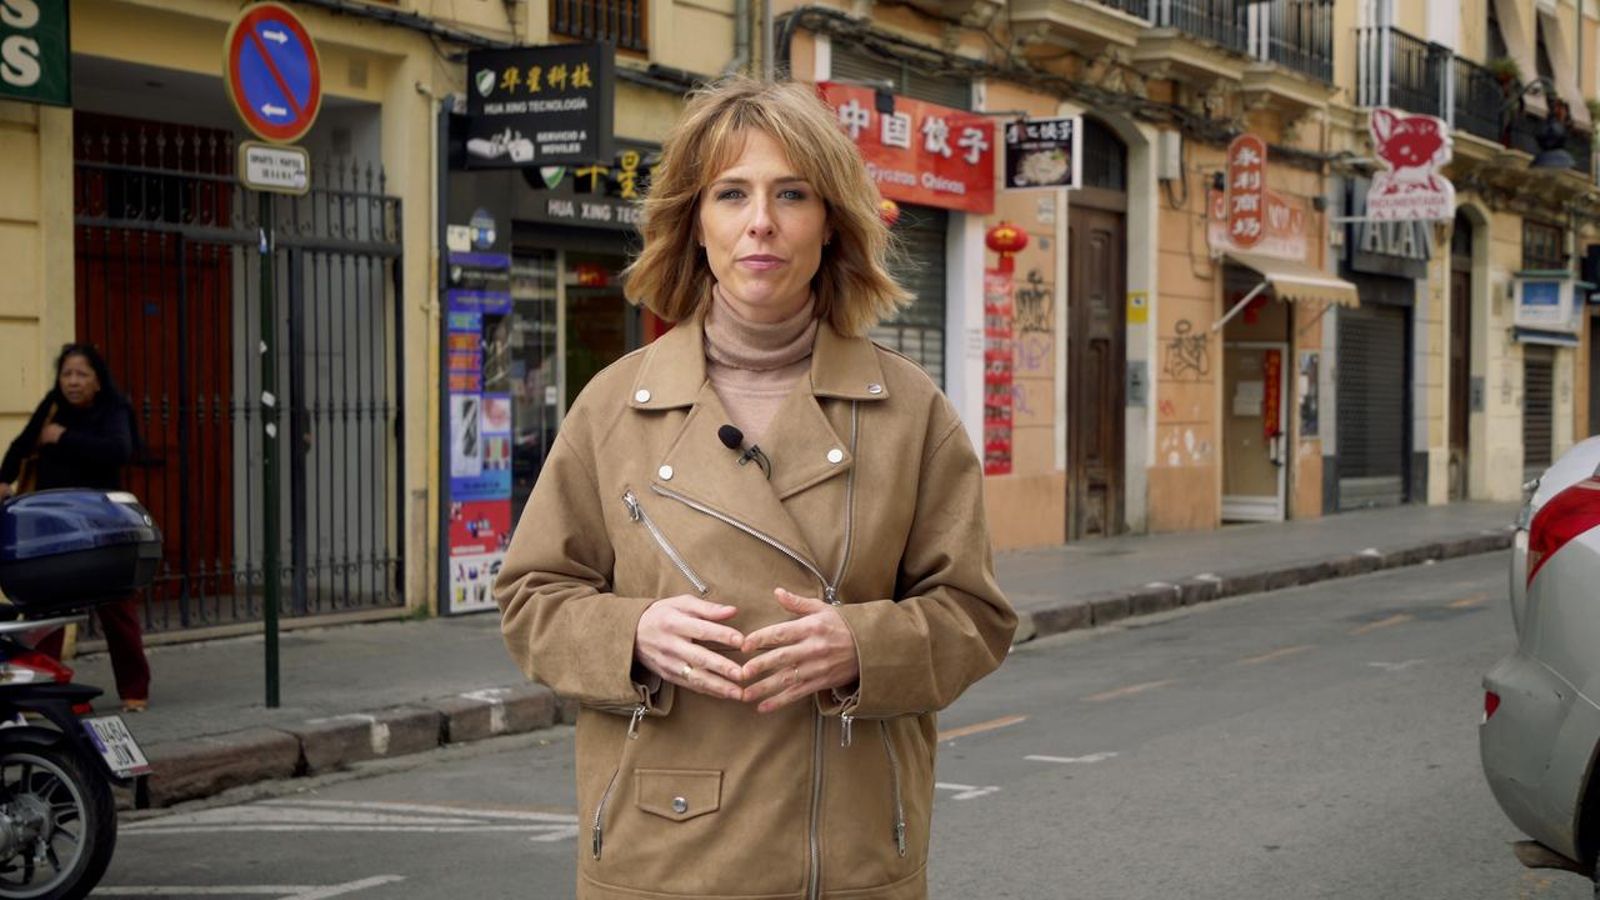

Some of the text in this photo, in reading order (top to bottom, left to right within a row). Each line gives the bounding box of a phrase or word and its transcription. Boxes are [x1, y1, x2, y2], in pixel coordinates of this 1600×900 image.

[484, 103, 502, 115] HUA
[505, 101, 526, 114] XING
[579, 130, 586, 140] A
[839, 98, 988, 165] 中国饺子
[547, 199, 574, 217] HUA
[581, 202, 611, 221] XING
